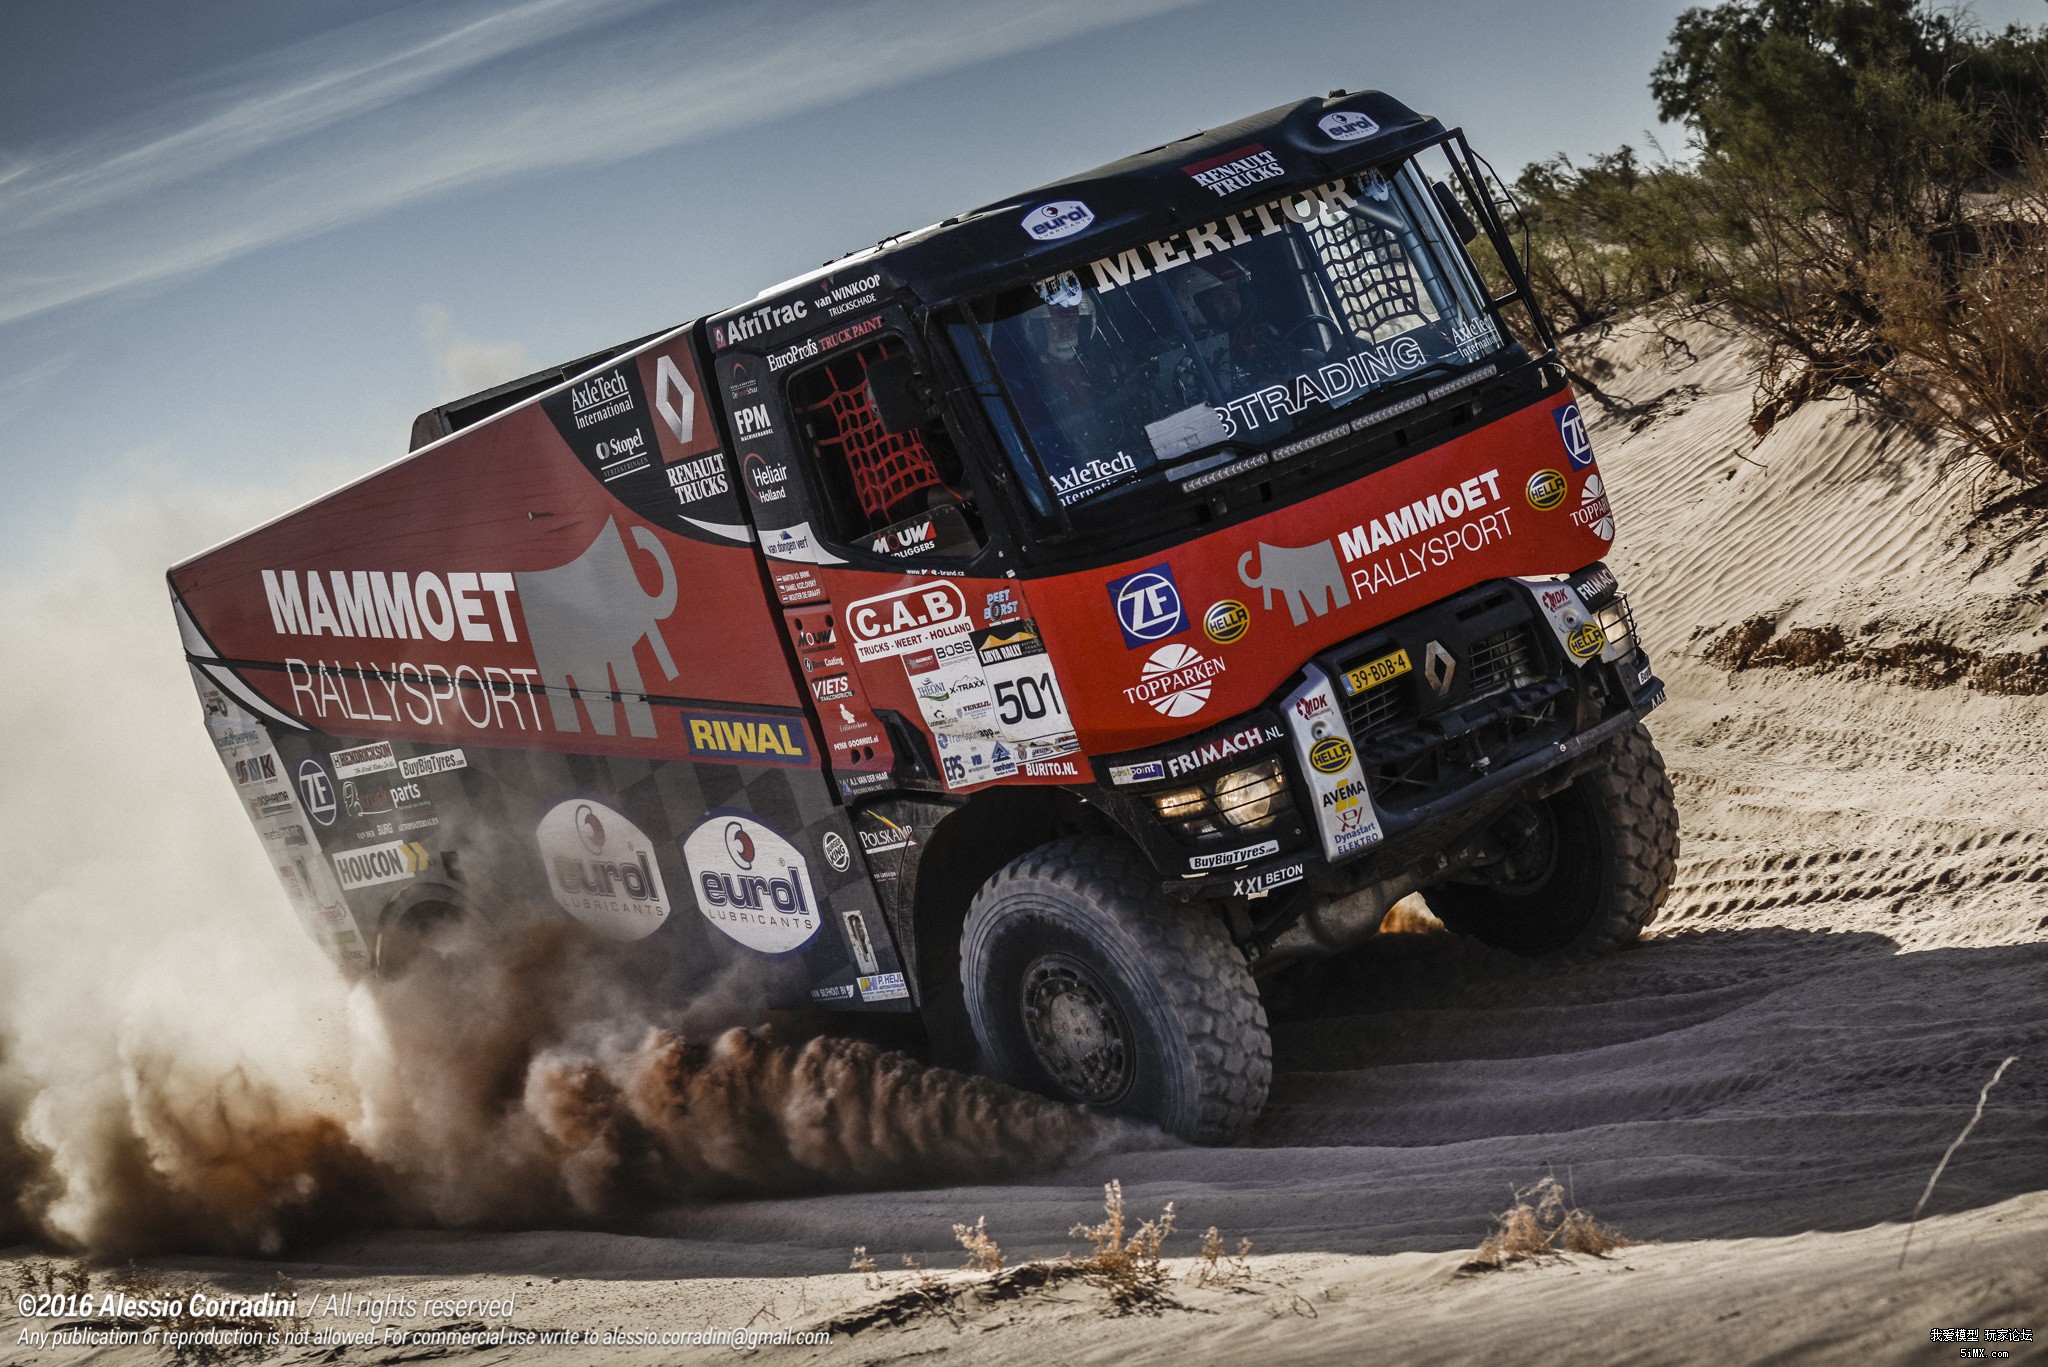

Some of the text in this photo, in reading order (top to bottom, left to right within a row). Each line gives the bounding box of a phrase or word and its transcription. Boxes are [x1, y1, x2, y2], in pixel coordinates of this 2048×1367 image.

[1328, 117, 1371, 136] eurol
[1192, 150, 1278, 188] RENAULT
[1208, 162, 1286, 197] TRUCKS
[1033, 205, 1088, 235] eurol
[1037, 216, 1092, 240] LUBRICANTS
[1089, 178, 1358, 294] MERITOR
[814, 274, 881, 309] van WINKOOP
[828, 293, 876, 317] TRUCKSCHADE
[727, 300, 808, 345] AfriTrac
[767, 316, 884, 372] EuroProfs TRUCK PAINT
[571, 370, 629, 410] AxleTech
[574, 396, 634, 429] International
[734, 404, 772, 434] FPM
[610, 428, 644, 456] Stopel
[1564, 417, 1590, 455] ZF
[666, 453, 726, 487] RENAULT
[752, 463, 787, 487] Heliair
[1050, 451, 1135, 492] AxleTech
[674, 474, 728, 505] TRUCKS
[759, 487, 786, 503] Holland
[1531, 478, 1565, 499] HELLA
[1338, 469, 1502, 563] MAMMOET
[767, 535, 809, 555] van dongen verf
[872, 521, 930, 554] MOUW
[1351, 507, 1512, 600] RALLYSPORT
[261, 569, 518, 642] MAMMOET
[987, 589, 1010, 605] PEET
[1119, 581, 1178, 632] ZF
[856, 590, 954, 638] C.A.B
[1210, 609, 1247, 633] HELLA
[859, 622, 971, 657] TRUCKS WEERT HOLLAND
[936, 641, 973, 659] BOSS
[980, 649, 1002, 664] LIBYA
[1001, 644, 1022, 659] RALLY
[1572, 630, 1602, 650] HELLA
[1123, 656, 1226, 704] TOPPARKEN
[1352, 654, 1406, 688] 39-BDB-4
[285, 658, 542, 732] RALLYSPORT
[812, 676, 848, 699] VIETS
[917, 682, 946, 697] THEONI
[949, 680, 986, 695] X-TRAXX
[994, 672, 1062, 725] 501
[1305, 694, 1328, 715] MDK
[690, 719, 802, 756] RIWAL
[833, 741, 848, 751] PETER
[339, 743, 393, 768] HENDRICKSON
[943, 755, 965, 781] EPS
[1026, 762, 1078, 776] BURITO.NL
[1314, 745, 1351, 766] HELLA
[299, 771, 336, 813] ZF
[1322, 780, 1365, 807] AVEMA
[377, 823, 393, 836] BURG
[859, 825, 913, 848] POLSKAMP
[1334, 822, 1375, 844] Dynastart
[1337, 833, 1379, 855] ELEKTRO
[336, 848, 404, 884] HOUCON
[829, 845, 846, 863] KING
[553, 851, 660, 902] eurol
[700, 866, 810, 915] eurol
[1233, 863, 1303, 896] XXL BETON
[562, 899, 664, 917] LUBRICANTS
[708, 908, 813, 930] LUBRICANTS
